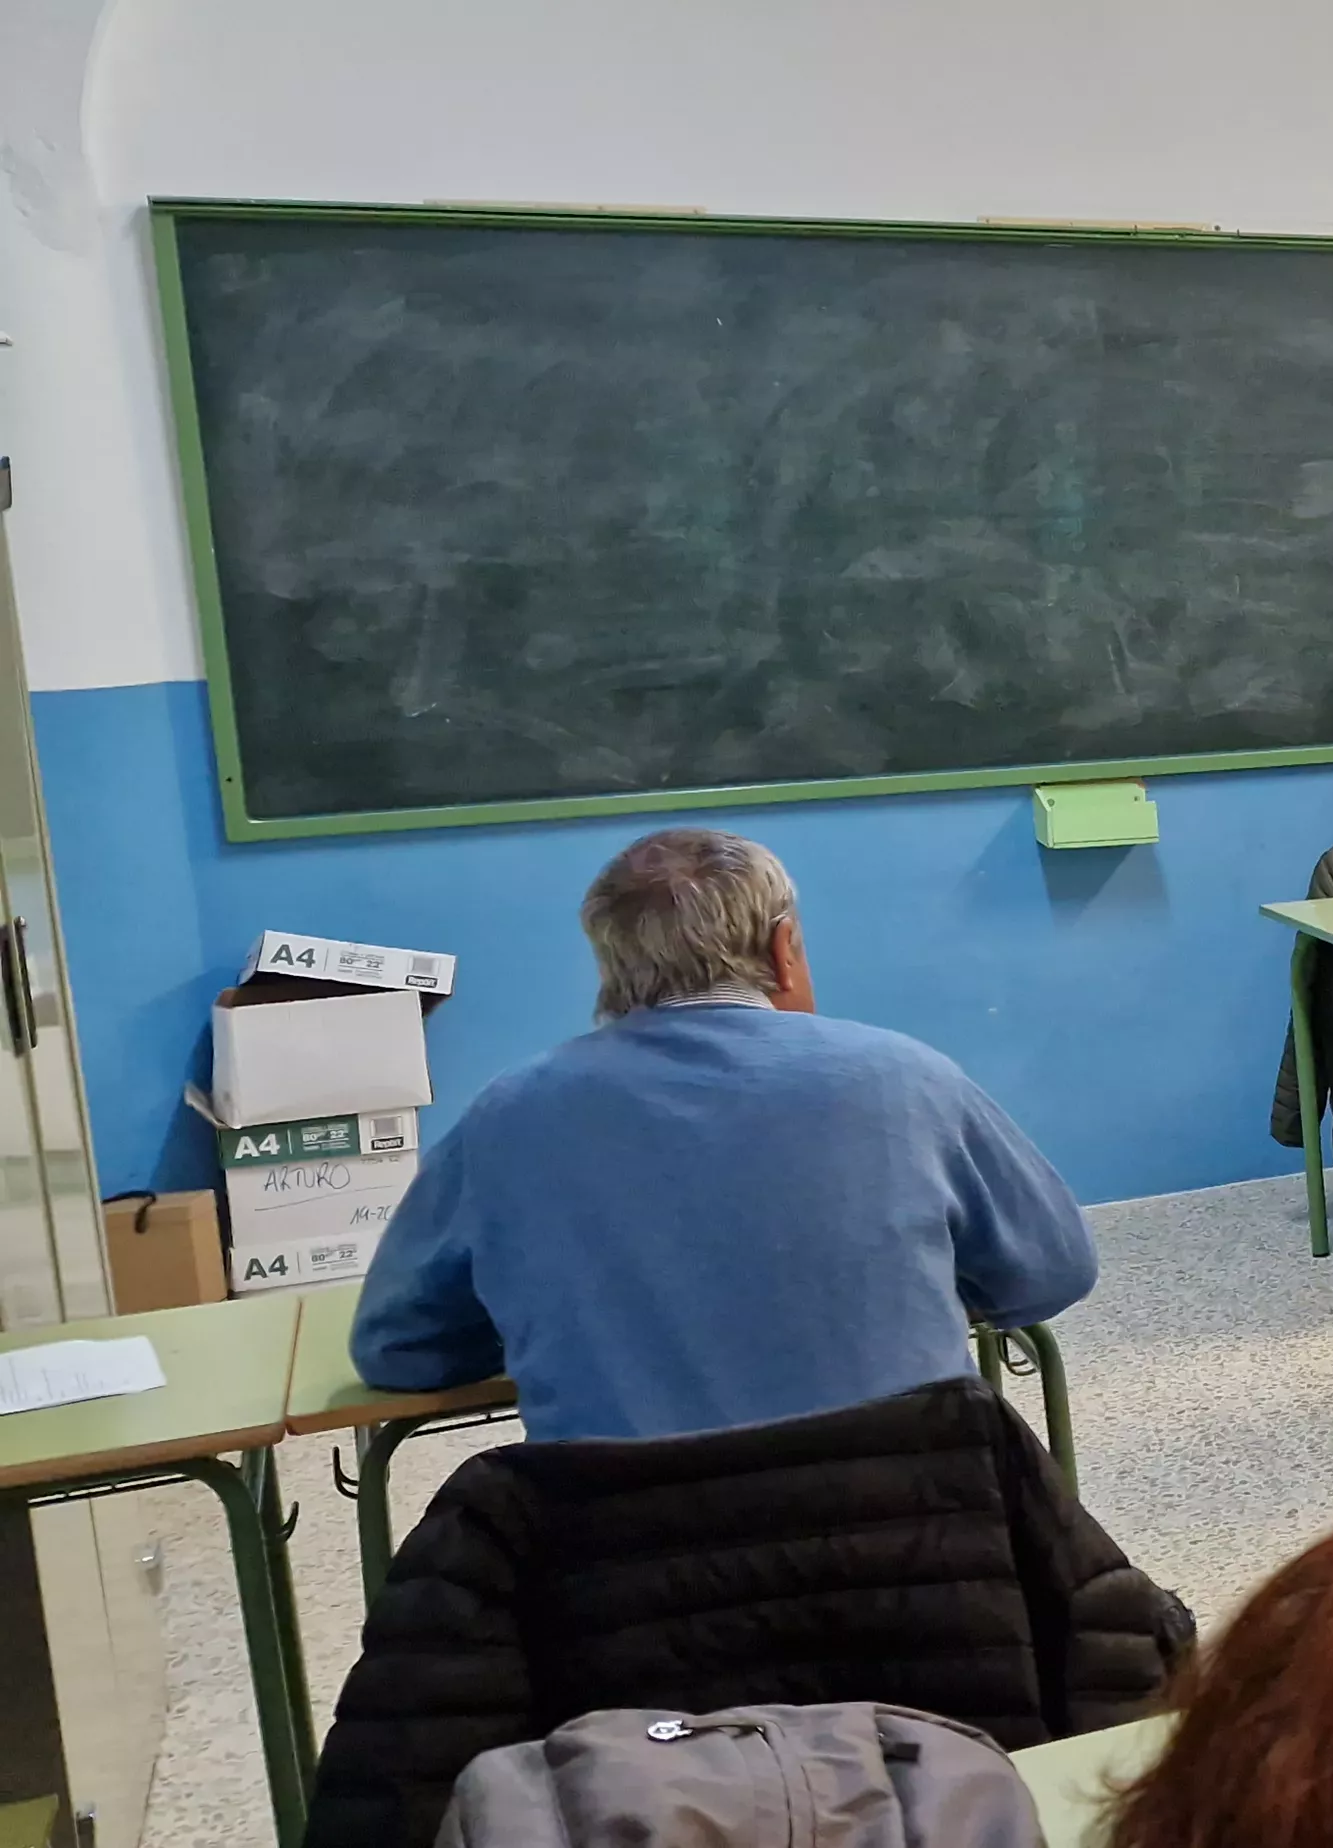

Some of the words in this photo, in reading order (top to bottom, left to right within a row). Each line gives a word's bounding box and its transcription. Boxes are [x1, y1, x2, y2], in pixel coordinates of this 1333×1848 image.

[269, 944, 316, 968] A4
[234, 1133, 281, 1159] A4
[264, 1162, 351, 1193] ARTURO
[244, 1254, 289, 1281] A4
